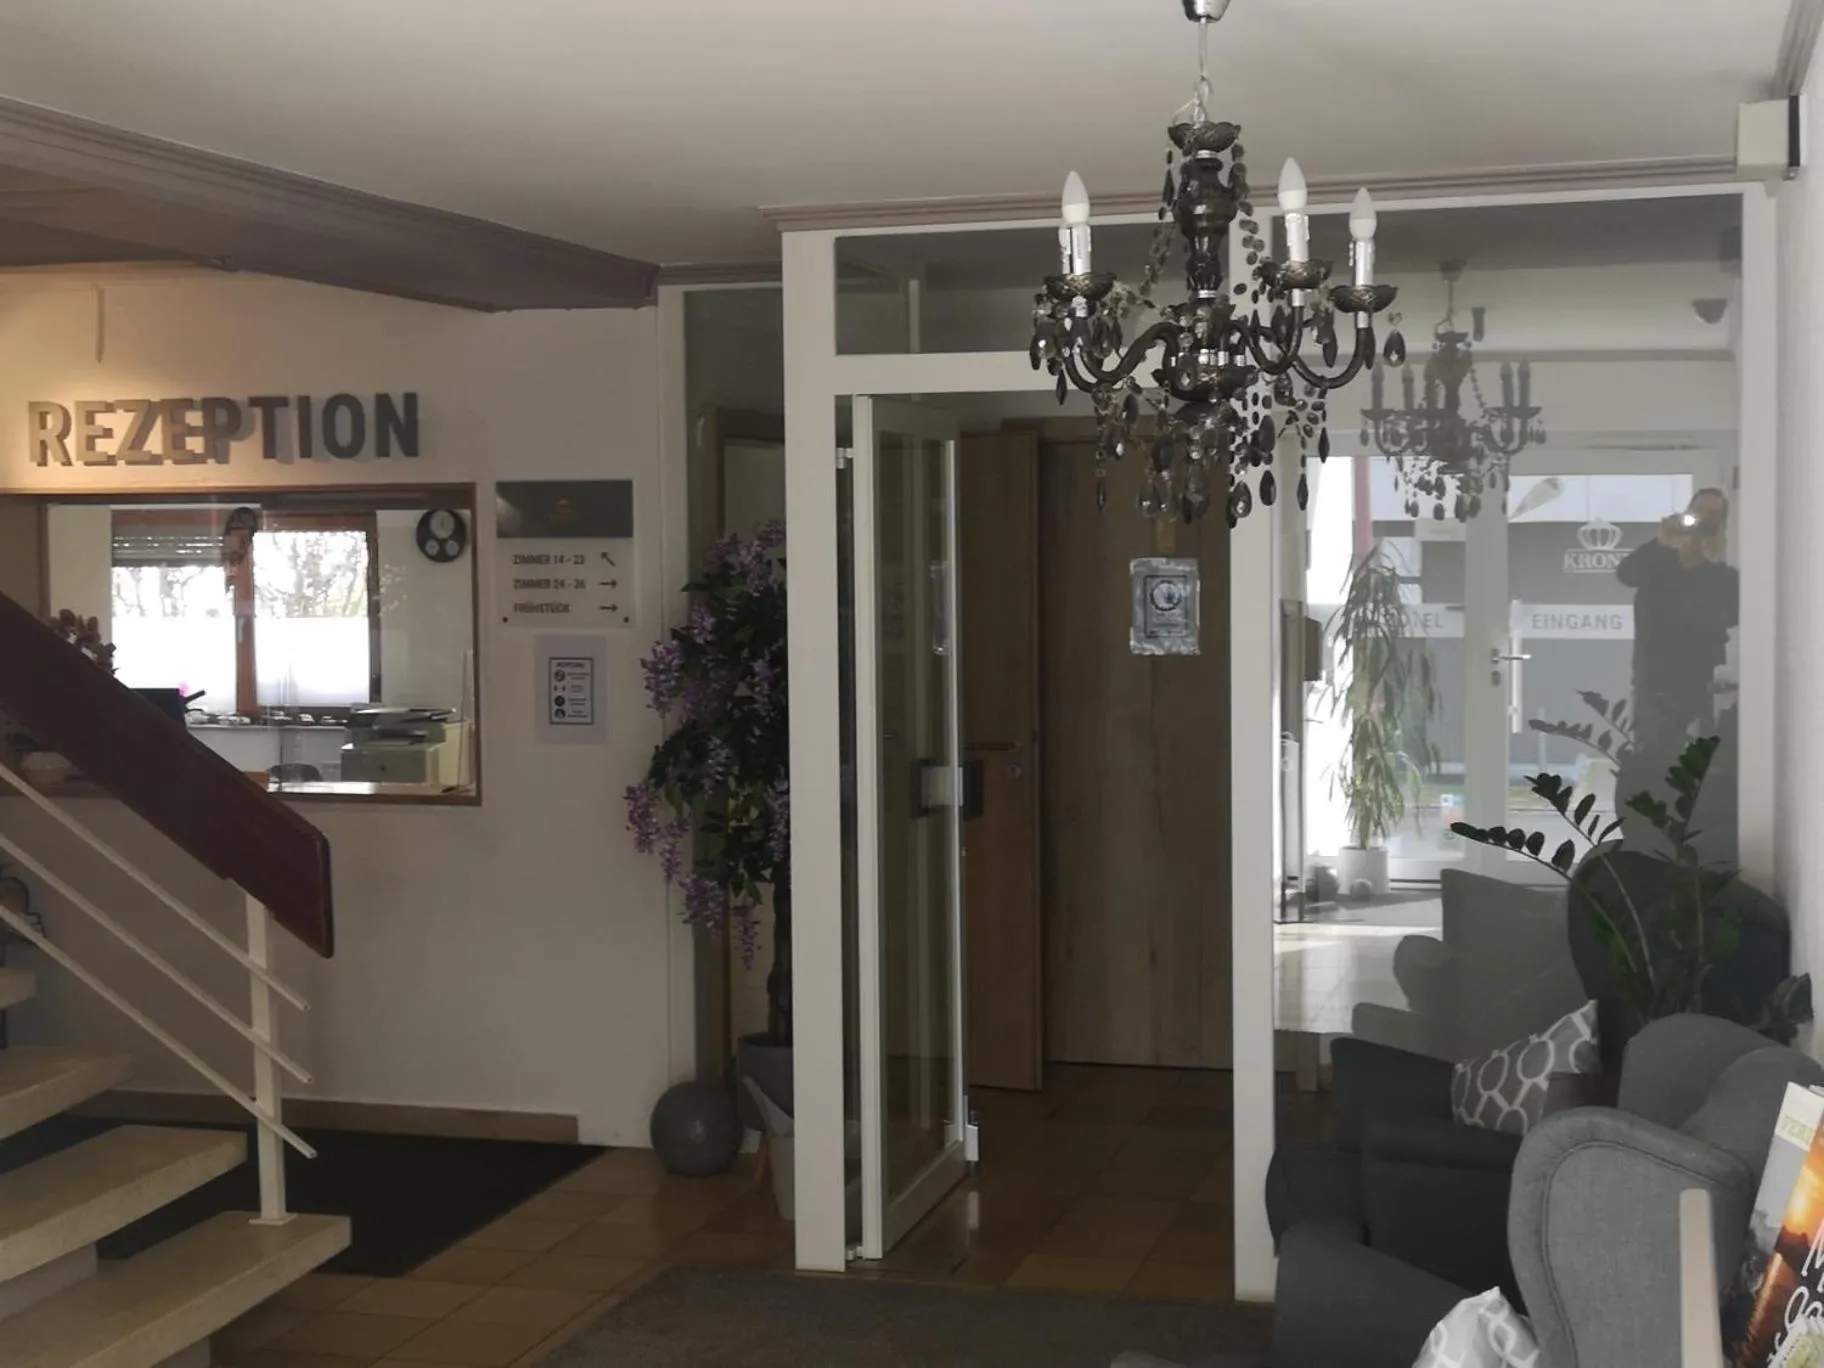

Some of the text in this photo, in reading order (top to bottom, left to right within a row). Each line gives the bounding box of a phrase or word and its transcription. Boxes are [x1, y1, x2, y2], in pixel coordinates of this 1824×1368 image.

[28, 393, 420, 464] REZEPTION
[513, 554, 550, 565] ZIMMER
[1565, 553, 1628, 569] KRON
[513, 578, 551, 589] ZIMMER
[1532, 614, 1624, 629] EINGANG
